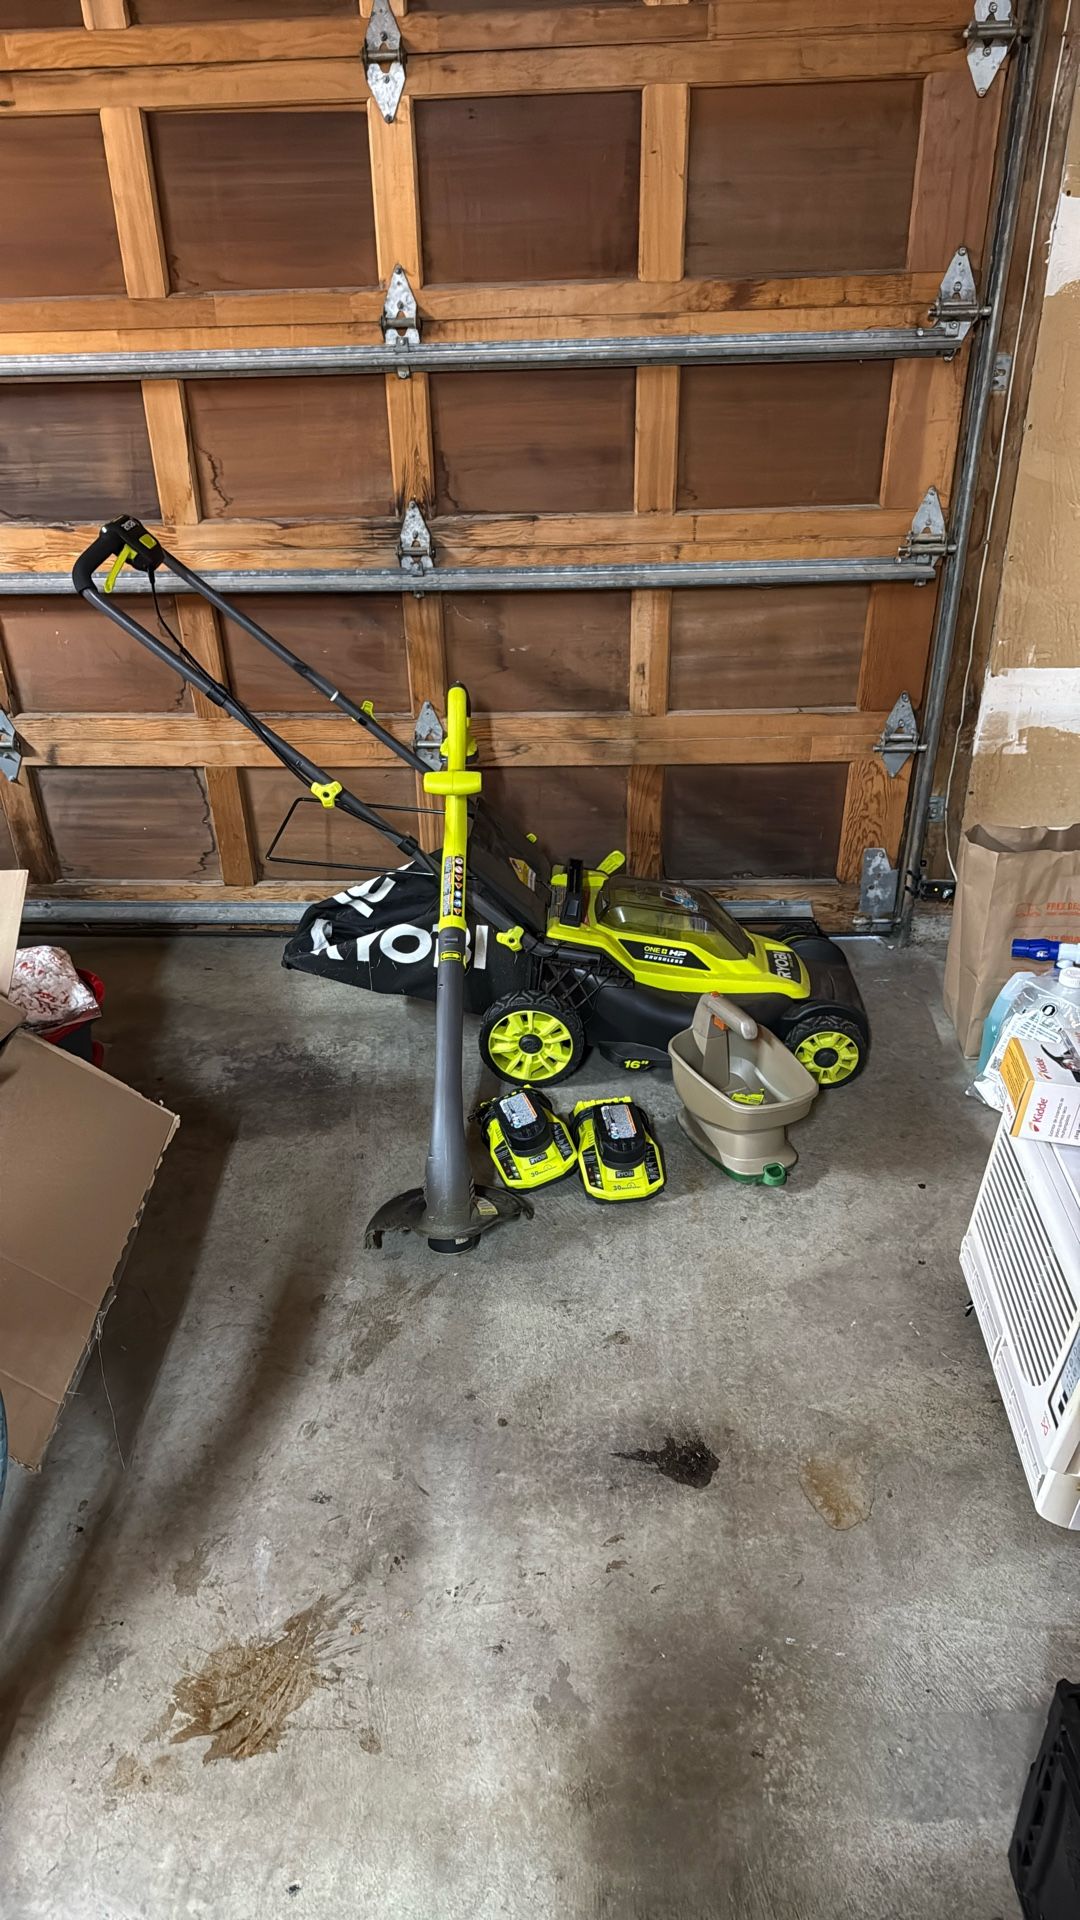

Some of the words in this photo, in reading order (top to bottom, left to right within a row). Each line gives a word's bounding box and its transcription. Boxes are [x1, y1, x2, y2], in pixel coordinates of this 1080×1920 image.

[668, 949, 688, 957] HP
[772, 950, 792, 979] RYOBI
[623, 1060, 649, 1069] 16"
[1032, 1096, 1049, 1123] Kidde
